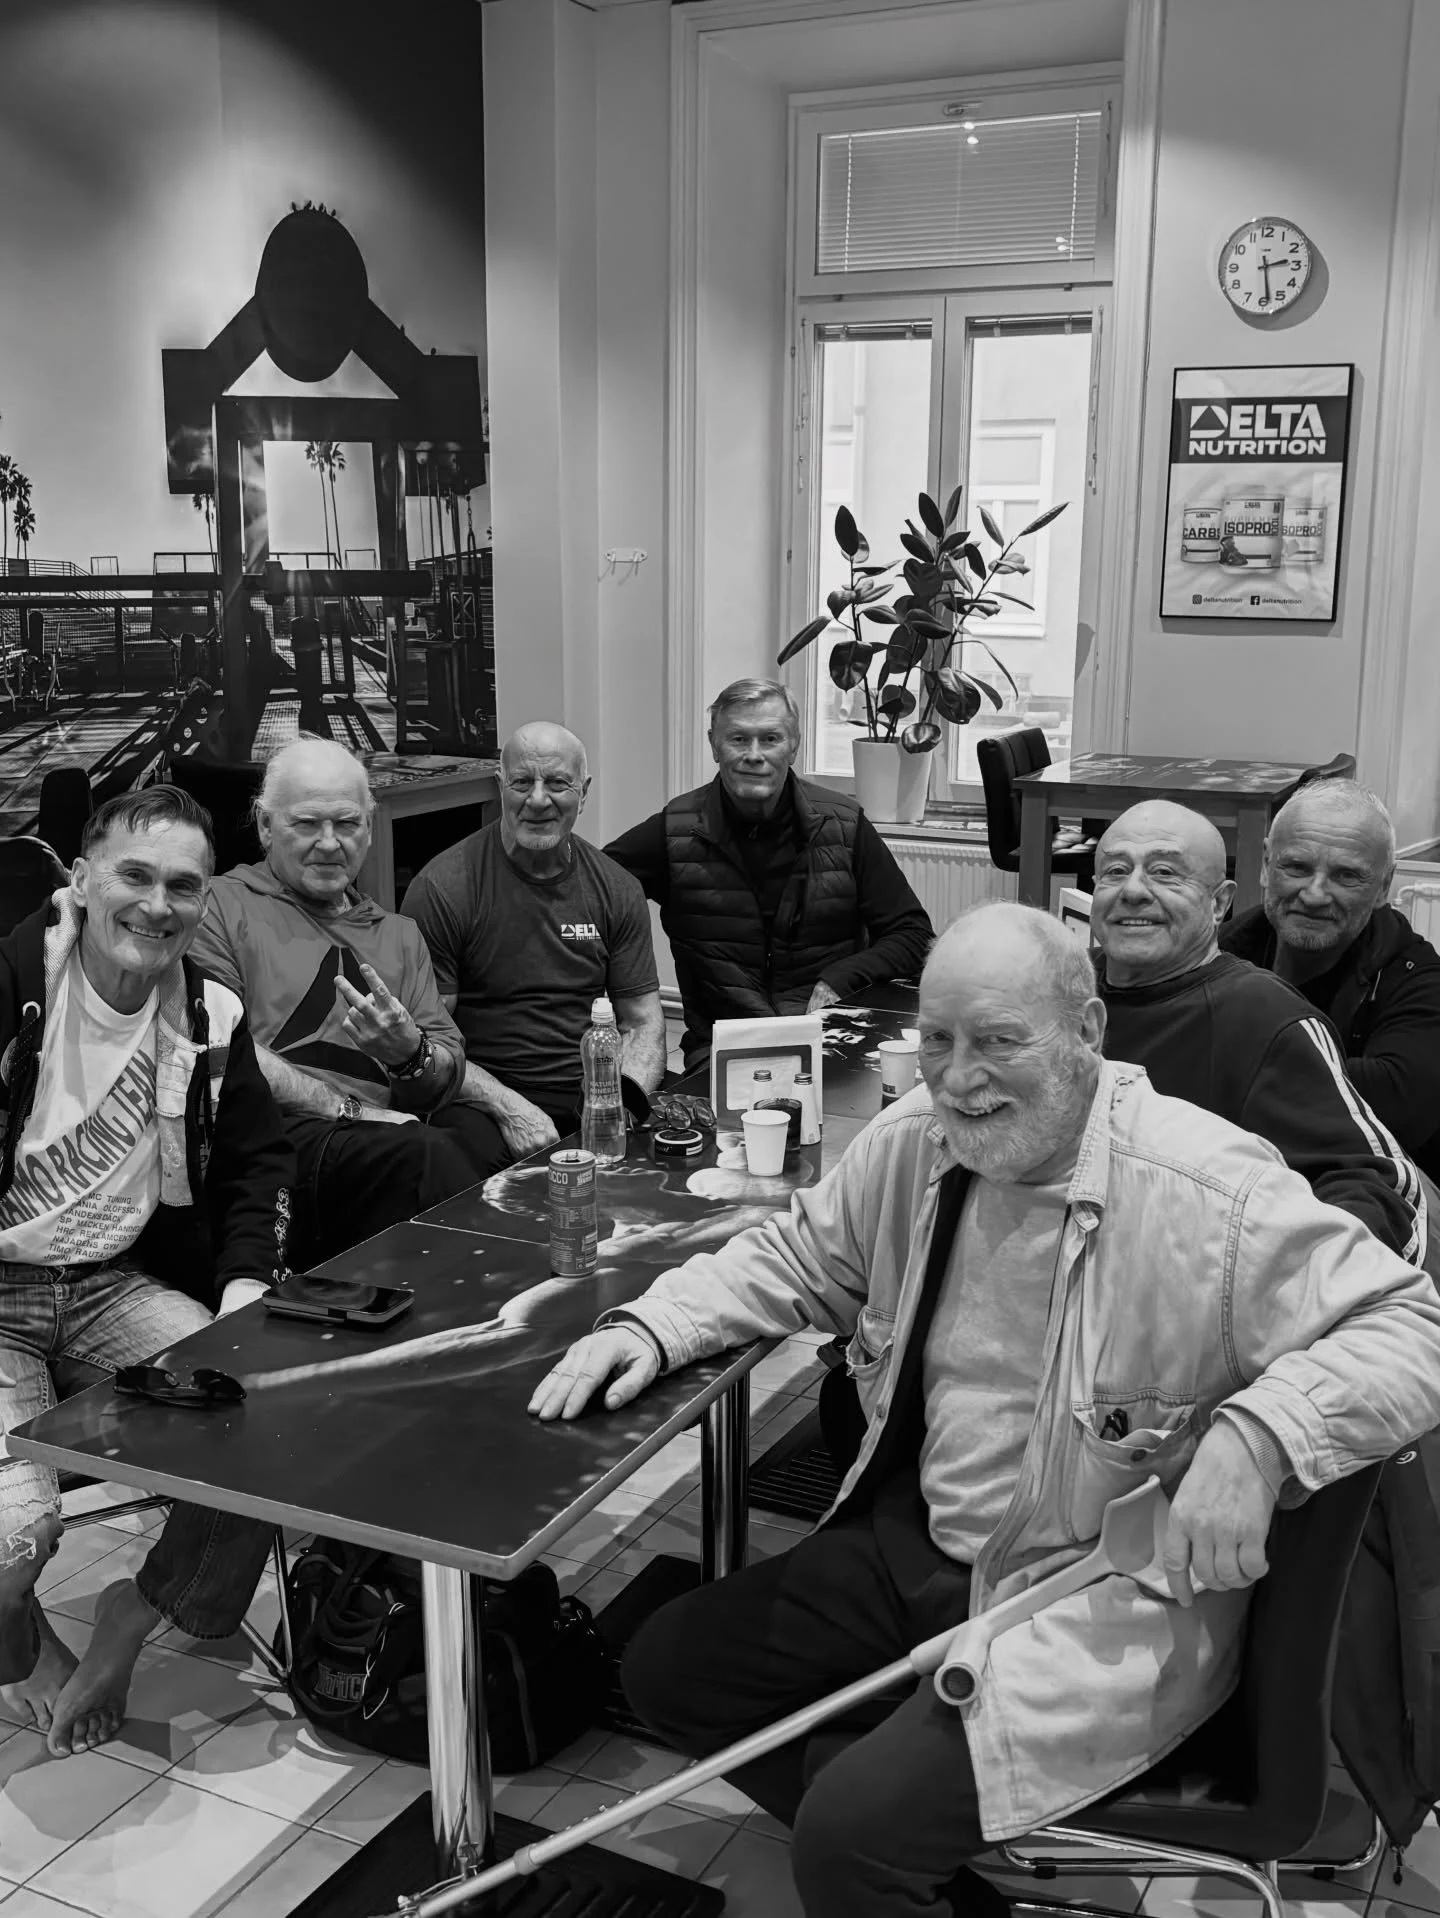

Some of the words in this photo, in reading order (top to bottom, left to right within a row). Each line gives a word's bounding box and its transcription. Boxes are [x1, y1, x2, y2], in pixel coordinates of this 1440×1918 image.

[1249, 231, 1257, 244] 11
[1261, 226, 1275, 239] 12
[1281, 231, 1285, 242] 1
[1234, 243, 1246, 255] 10
[1288, 242, 1300, 254] 2
[1228, 263, 1239, 273] 9
[1290, 260, 1302, 272] 3
[1231, 279, 1241, 290] 8
[1286, 277, 1297, 288] 4
[1244, 292, 1253, 303] 7
[1275, 290, 1286, 301] 5
[1258, 296, 1269, 307] 6
[1189, 403, 1327, 439] DELTA
[1188, 439, 1327, 456] NUTRITION
[1224, 521, 1271, 534] ISOPRO
[46, 1108, 136, 1196] RACING
[103, 1204, 142, 1215] OLOFSSON
[59, 1216, 72, 1224] SP
[49, 1244, 71, 1254] TIMO
